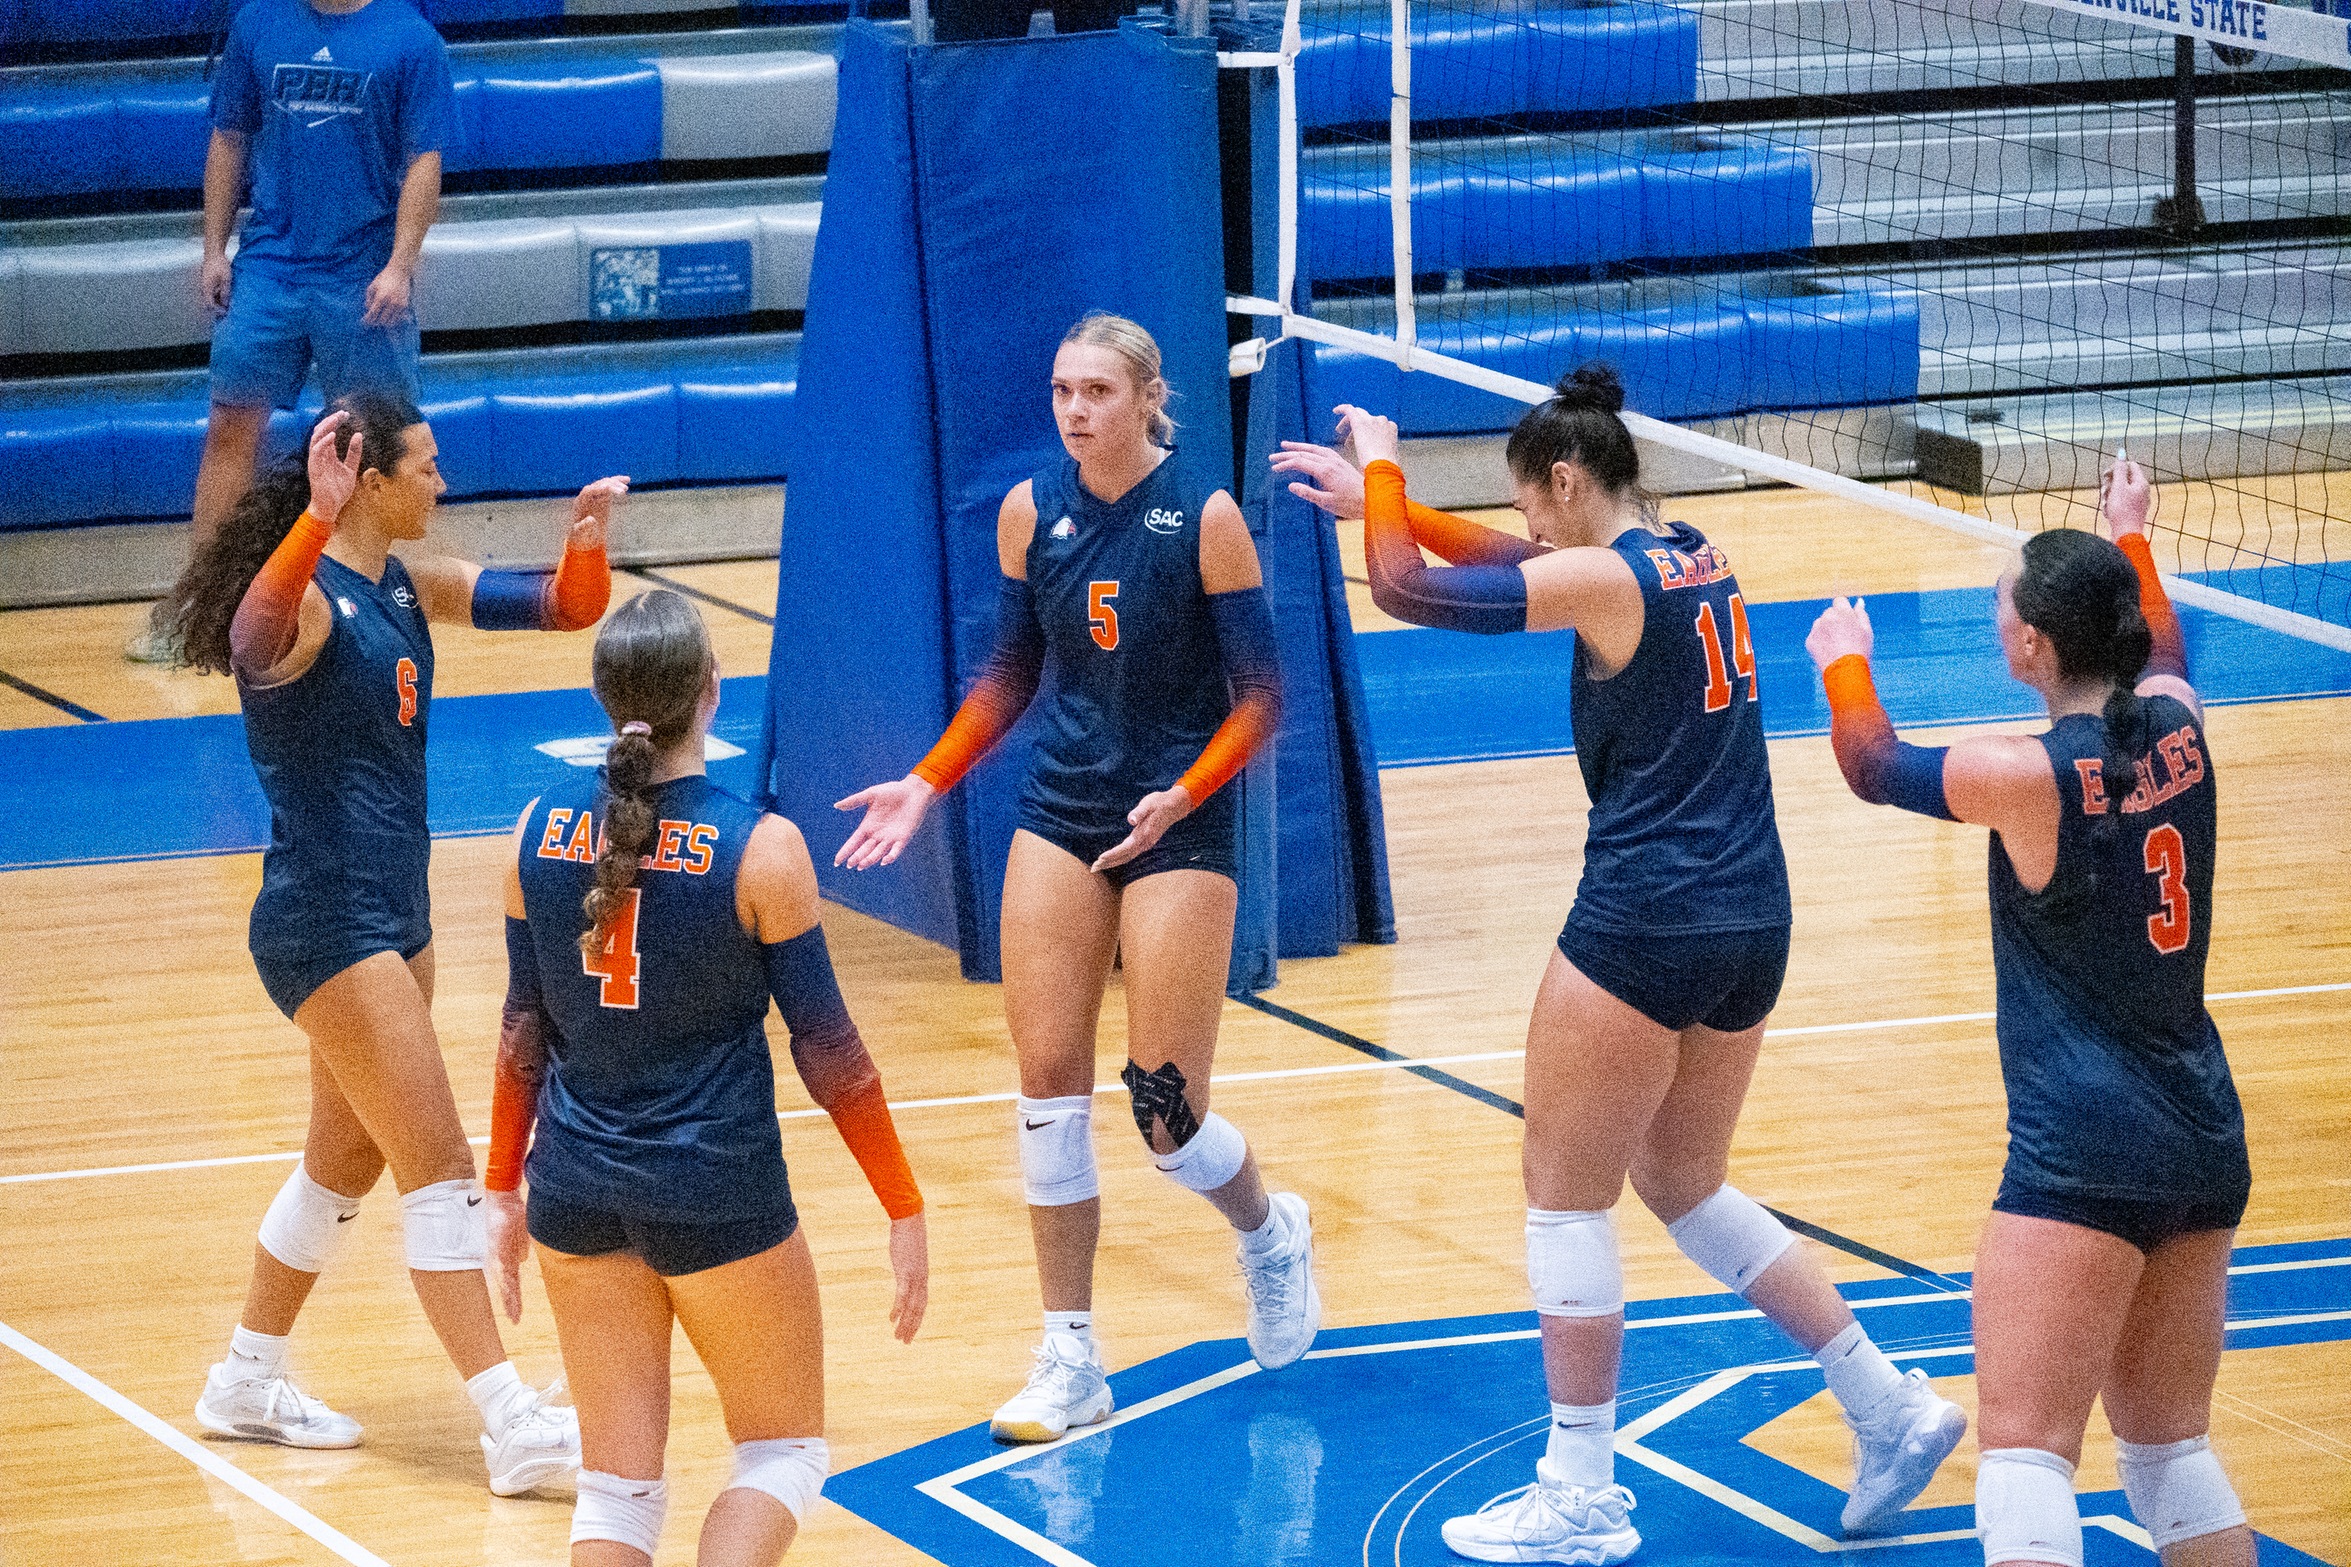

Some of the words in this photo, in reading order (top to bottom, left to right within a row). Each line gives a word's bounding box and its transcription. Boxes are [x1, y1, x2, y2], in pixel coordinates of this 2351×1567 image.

[2190, 0, 2267, 41] STATE
[1149, 508, 1183, 527] SAC
[1088, 580, 1120, 651] 5
[1695, 592, 1758, 713] 14
[396, 657, 418, 727] 6
[2074, 726, 2204, 816] EGLES
[536, 808, 720, 875] EAES
[2143, 822, 2191, 955] 3
[580, 888, 642, 1010] 4
